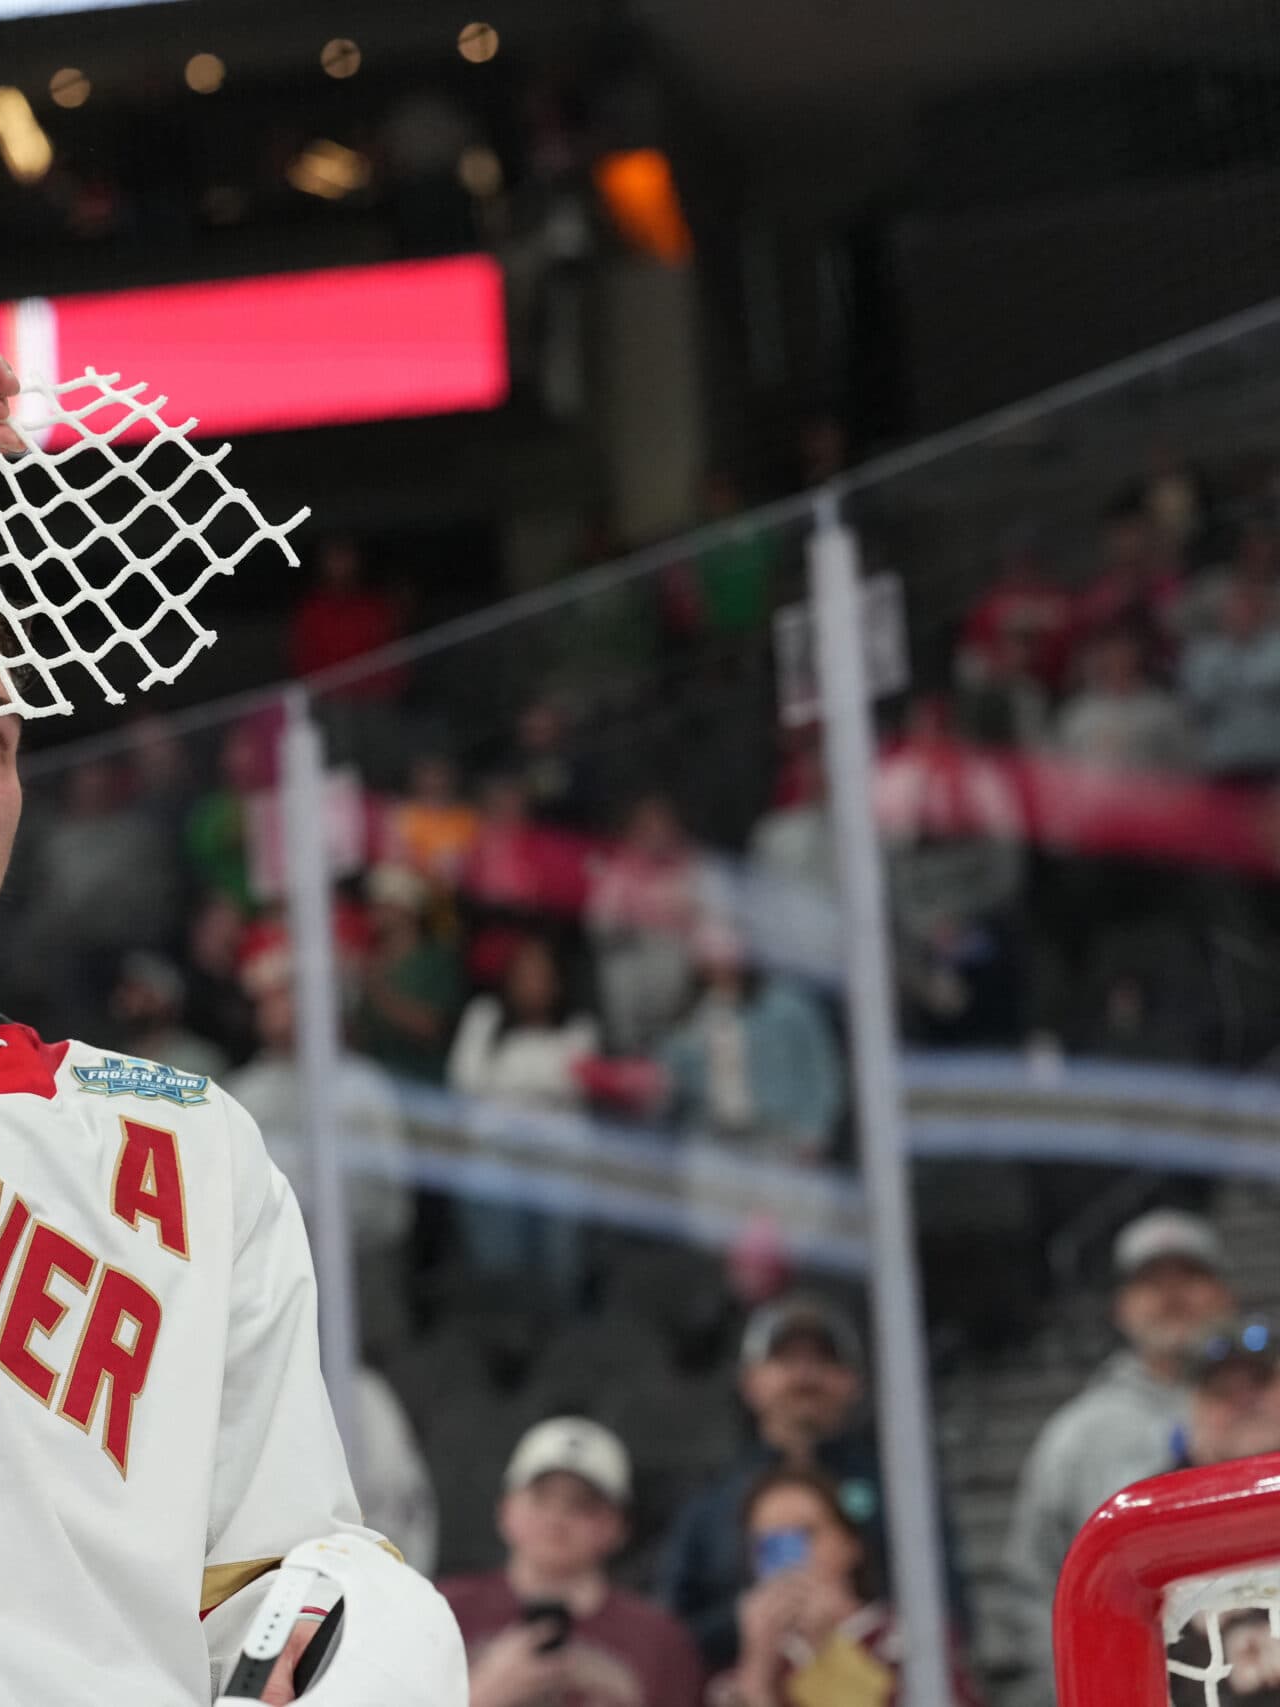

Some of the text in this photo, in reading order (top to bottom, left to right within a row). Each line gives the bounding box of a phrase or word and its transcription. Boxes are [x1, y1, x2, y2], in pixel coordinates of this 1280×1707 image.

[87, 1070, 152, 1082] FROZEN
[156, 1076, 199, 1088] FOUR
[139, 1081, 167, 1089] VEGAS
[111, 1113, 191, 1262] A
